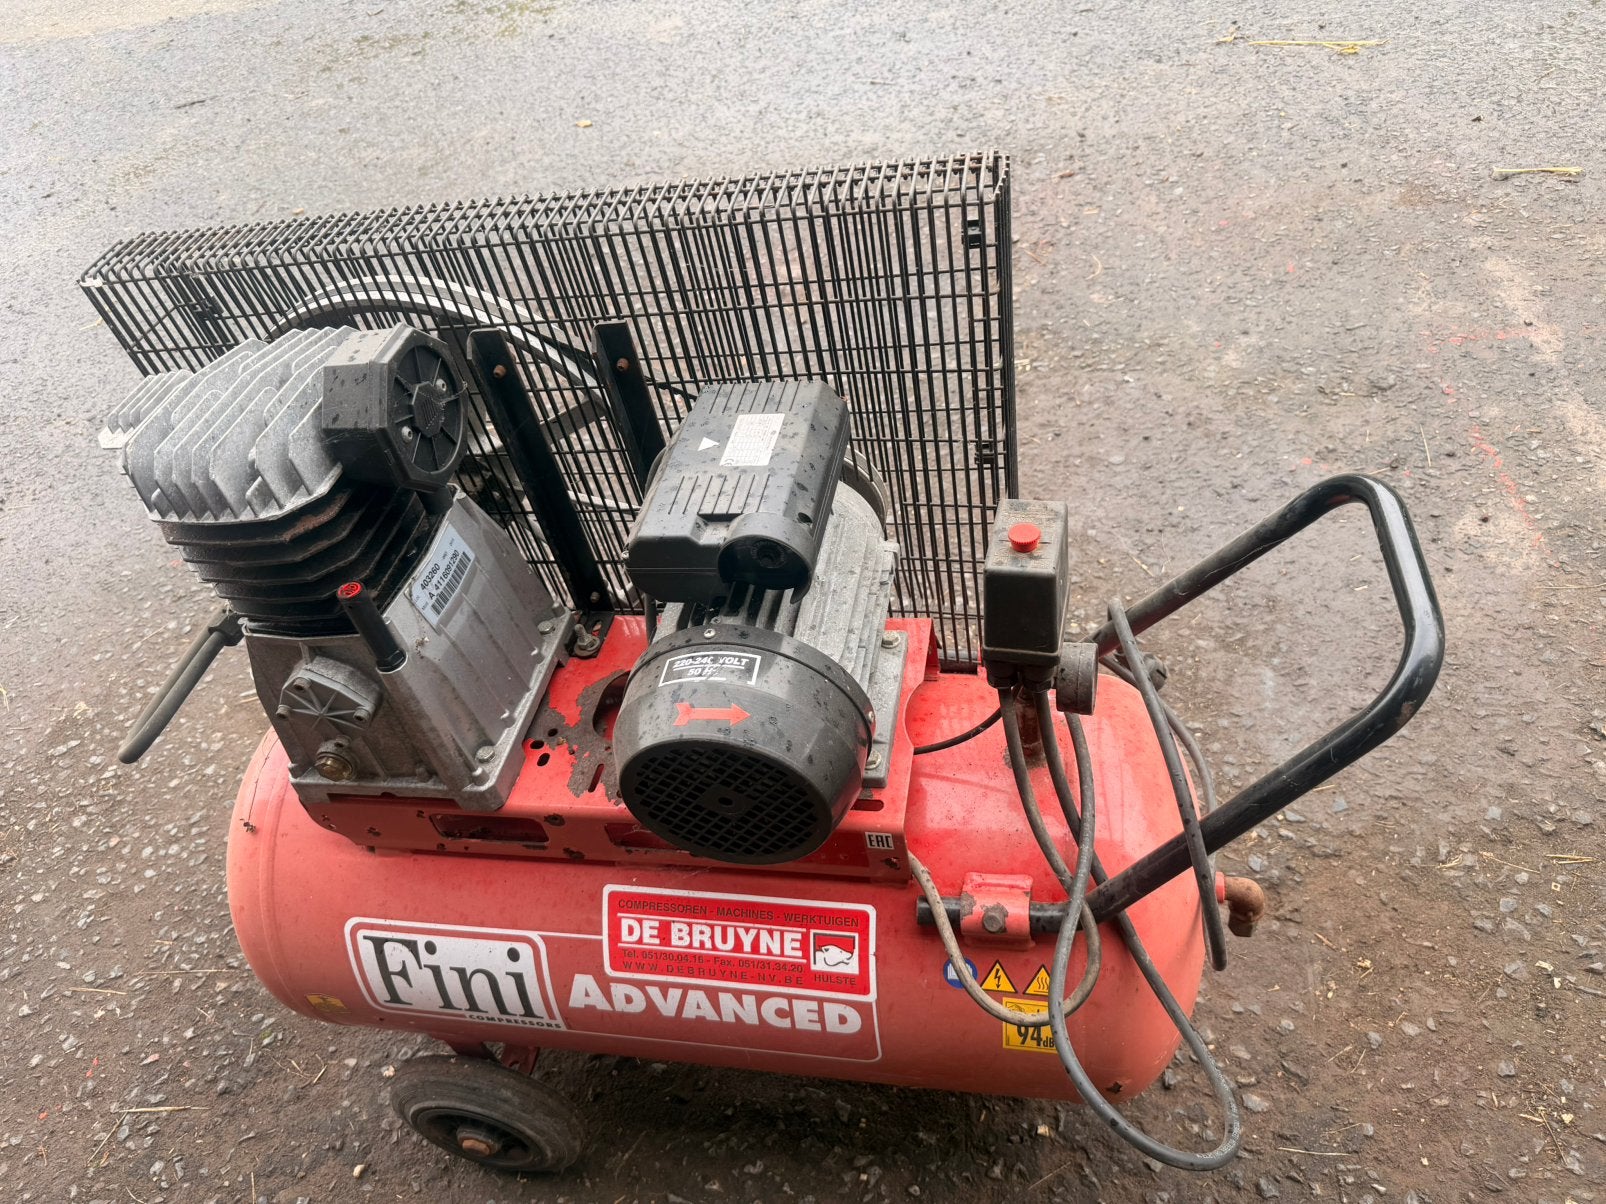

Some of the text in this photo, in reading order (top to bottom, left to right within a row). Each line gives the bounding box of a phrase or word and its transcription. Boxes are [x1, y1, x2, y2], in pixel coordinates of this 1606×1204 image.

[420, 563, 440, 591] 403260
[687, 668, 701, 676] 50
[719, 656, 750, 666] VOLT
[867, 834, 893, 849] EAC
[618, 899, 707, 915] COMPRESSOREN
[717, 907, 774, 921] MACHINES
[783, 912, 859, 927] WERKTUIGEN
[621, 917, 803, 957] DE BRUYNE
[622, 948, 639, 958] Tel.
[642, 951, 704, 964] 051/30.04.16
[713, 956, 735, 968] Fax.
[738, 960, 804, 973] 051/31.34.20
[363, 935, 544, 1019] Fini
[814, 974, 857, 986] HULSTE
[568, 973, 862, 1034] ADVANCED
[468, 1014, 562, 1029] COMPRESSORS
